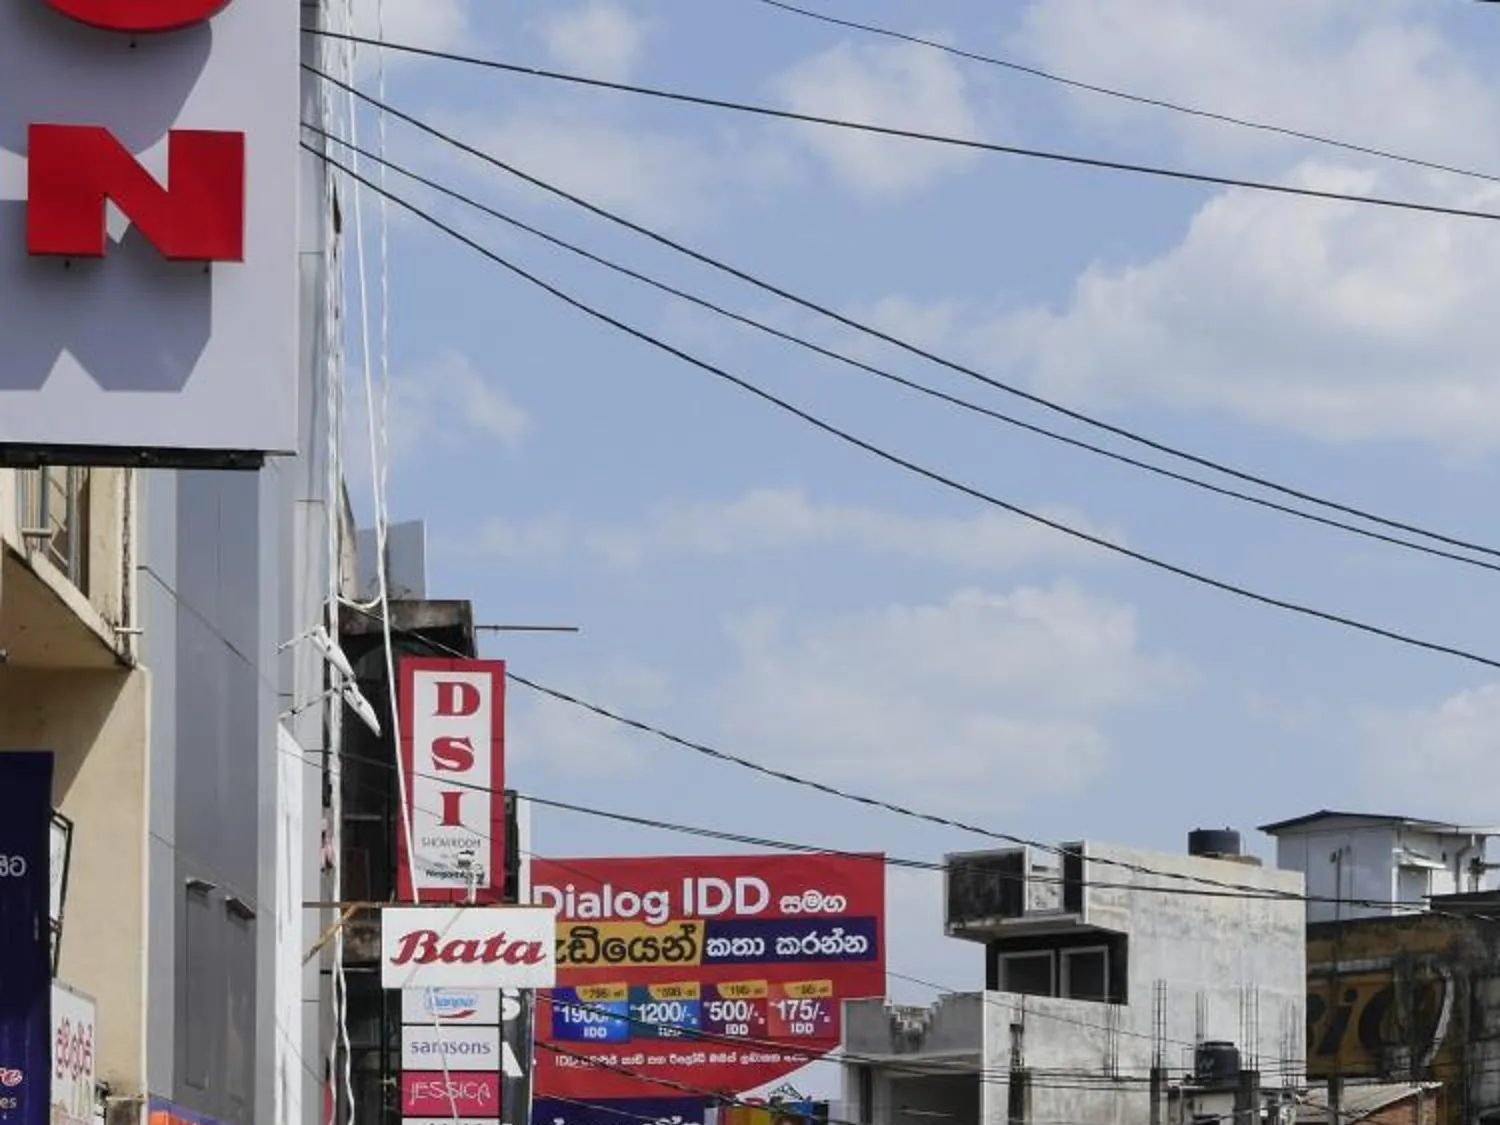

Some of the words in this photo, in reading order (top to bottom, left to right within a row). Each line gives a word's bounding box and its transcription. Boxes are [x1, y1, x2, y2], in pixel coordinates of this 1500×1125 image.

[533, 884, 670, 925] Dialog
[682, 876, 771, 916] IDD
[390, 929, 546, 965] Bata
[725, 1024, 749, 1035] IDD
[790, 1023, 814, 1034] IDD
